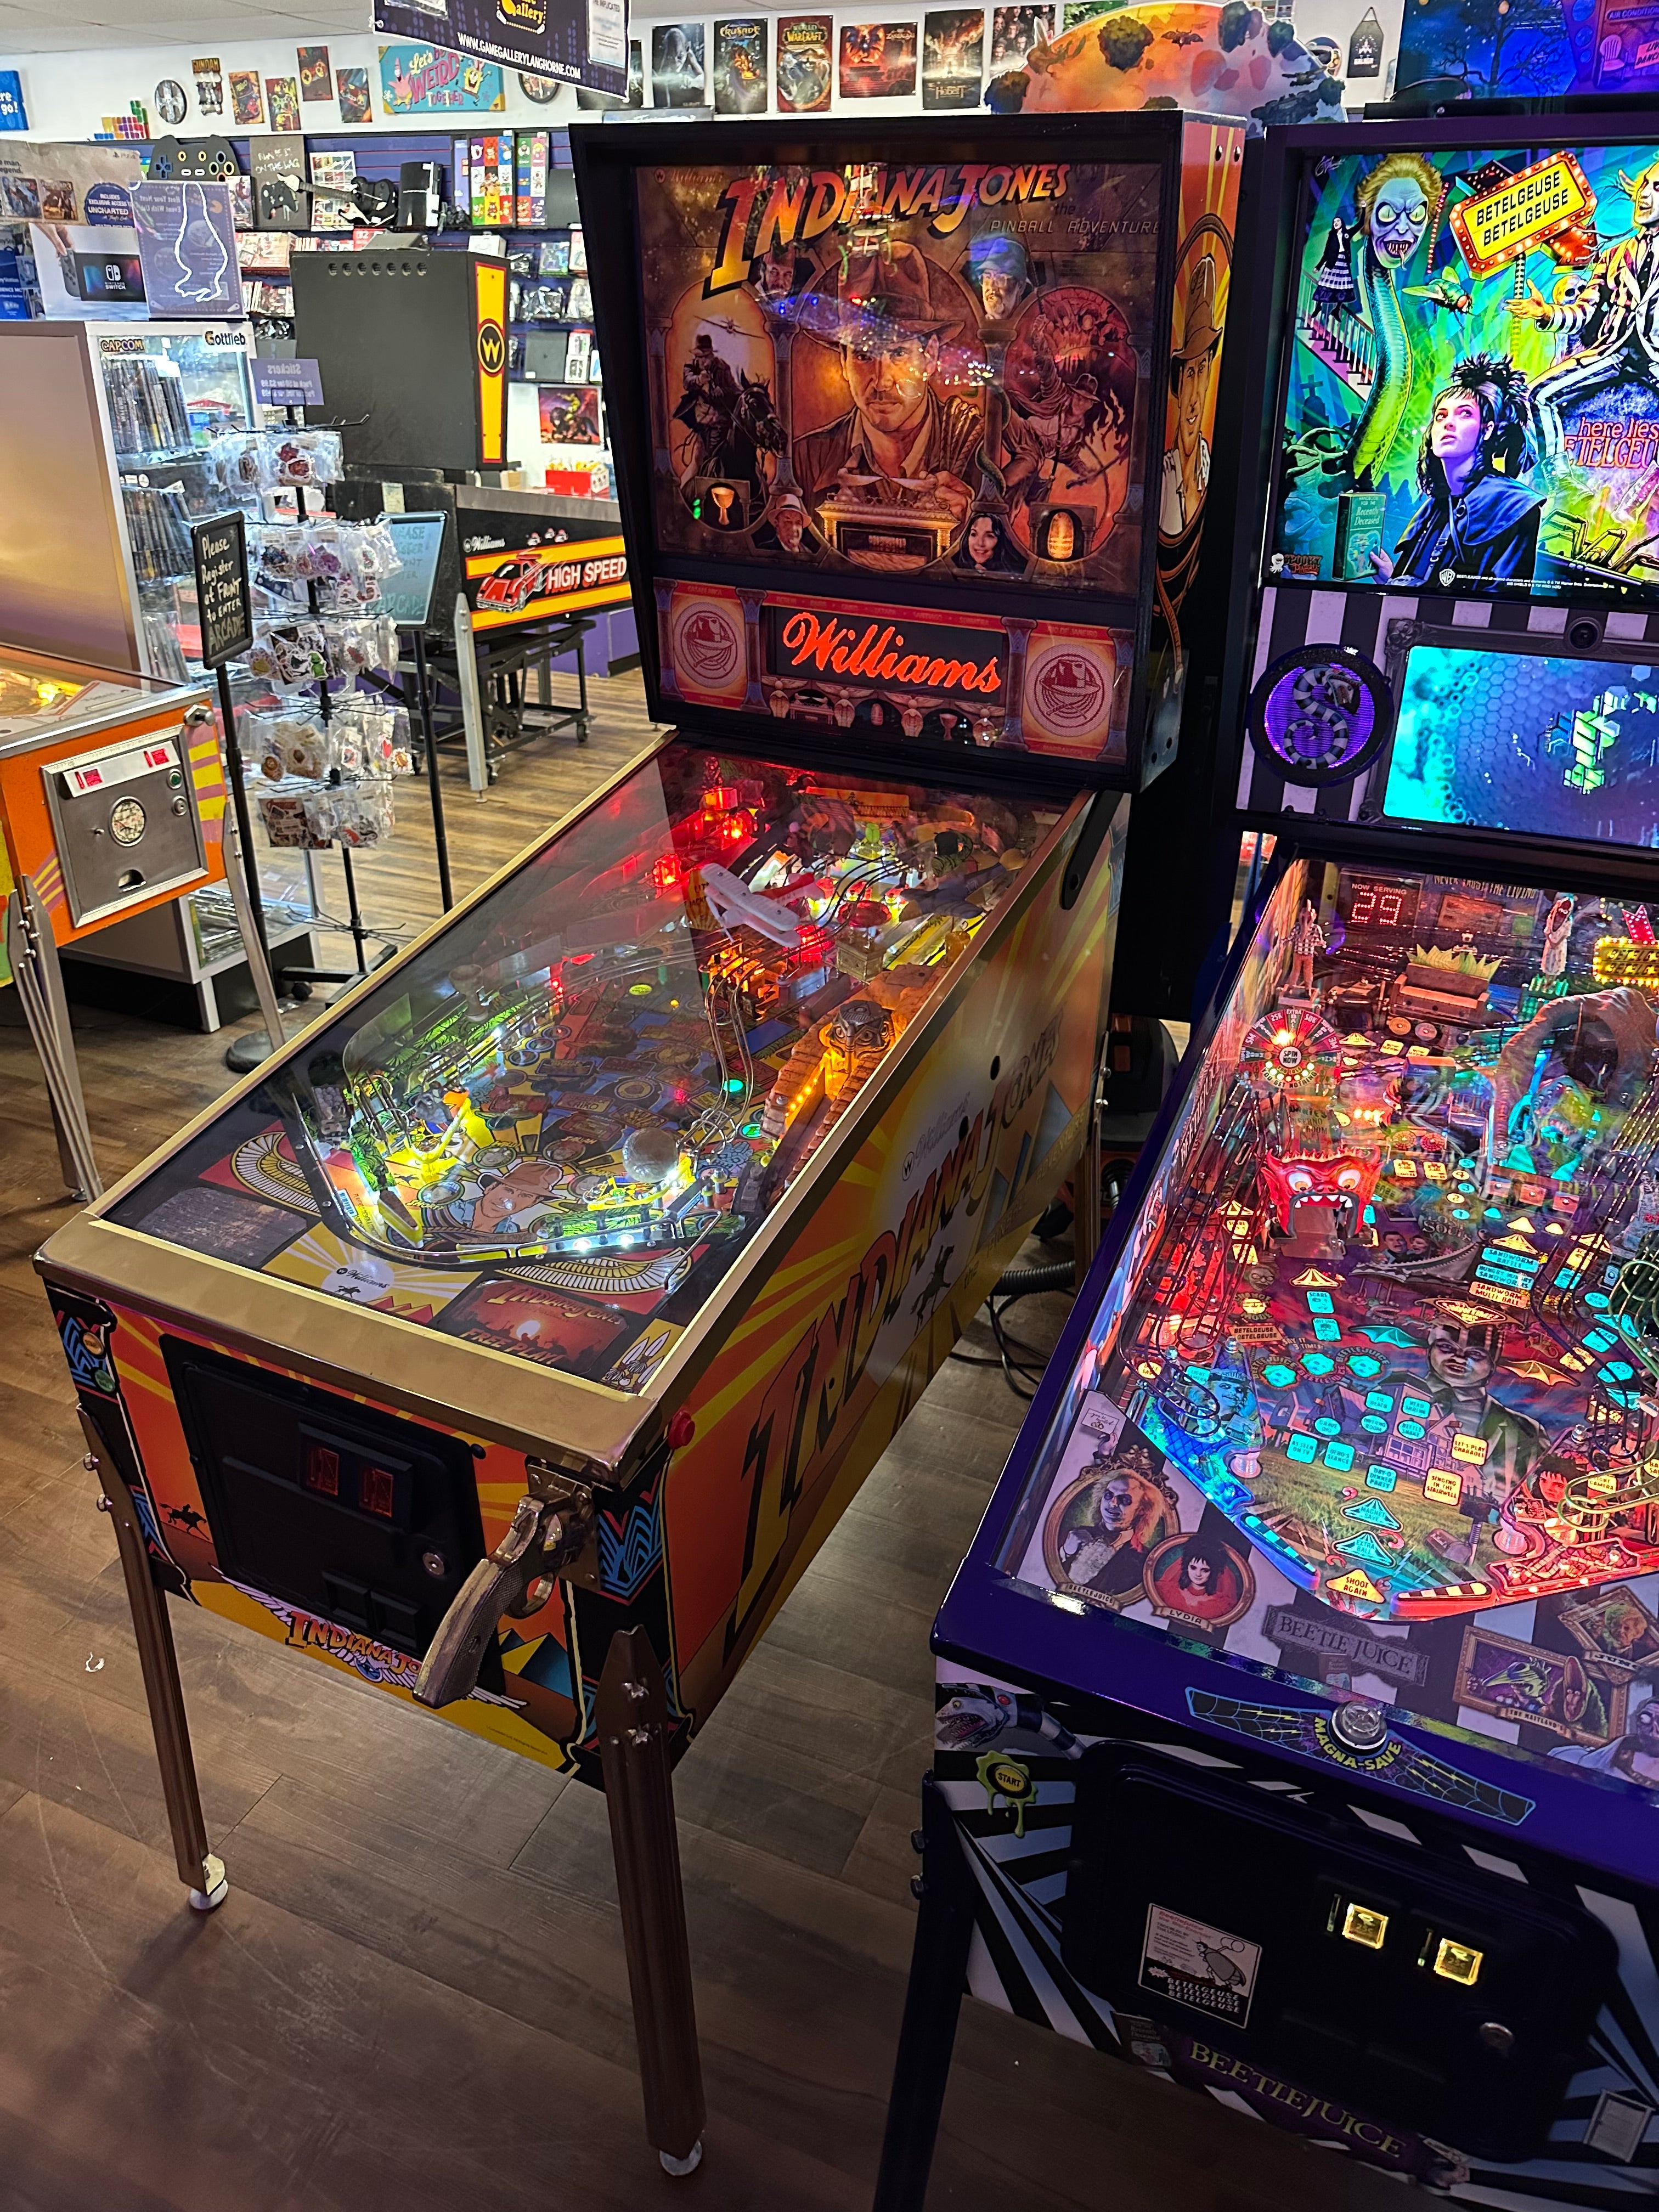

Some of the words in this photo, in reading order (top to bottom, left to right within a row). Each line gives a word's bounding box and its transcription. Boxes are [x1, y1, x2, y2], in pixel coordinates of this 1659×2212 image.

[720, 26, 761, 37] CRUSADE
[787, 31, 822, 42] WARCRAFT
[410, 50, 433, 75] Let's
[458, 32, 581, 80] WWW.GAMEGALLERYLANGHORNE.COM
[193, 59, 220, 72] GUNDAM
[935, 86, 966, 99] HOBBIT
[284, 158, 301, 170] LAG
[1476, 170, 1561, 227] BETELGEUSE
[88, 207, 129, 216] UNCHARTED
[1483, 188, 1569, 246] BETELGEUSE
[707, 166, 943, 295] INDIANA
[932, 165, 1071, 233] JONES
[989, 219, 1054, 234] PINBALL
[1068, 219, 1158, 234] ADVENTURE
[100, 338, 144, 352] CAPCOM
[205, 330, 246, 346] Gottlieb
[1578, 416, 1623, 438] here
[1627, 417, 1659, 439] lies
[1356, 506, 1379, 516] Recently
[1354, 516, 1380, 526] Deceased
[201, 534, 230, 560] Please
[471, 535, 505, 551] Williams
[201, 560, 234, 586] Register
[548, 565, 582, 591] HIGH
[584, 557, 627, 584] SPEED
[204, 585, 215, 606] at
[217, 577, 242, 602] FRONT
[207, 608, 216, 623] to
[218, 597, 242, 618] ENTER
[208, 612, 246, 656] ARCADE
[782, 611, 1001, 693] Williams
[1373, 885, 1407, 896] SERVING
[1271, 1012, 1283, 1022] 25K
[1262, 1067, 1273, 1081] YOU
[1273, 1079, 1286, 1088] GET
[1289, 1070, 1318, 1088] NOTHING
[1489, 1249, 1534, 1266] SANDWORM
[1497, 1257, 1522, 1268] BATTLE
[347, 1270, 391, 1288] Williams
[1479, 1265, 1504, 1276] HUNGRY
[1475, 1289, 1498, 1300] MULTI
[1502, 1296, 1519, 1306] BALL
[1477, 1283, 1522, 1300] SANDWORM
[487, 1284, 576, 1314] INDIANA
[563, 1305, 625, 1325] JONES
[460, 1328, 513, 1348] FREE
[507, 1343, 565, 1365] PLAY!
[1336, 1347, 1390, 1365] BEETLEJUICE
[1251, 1356, 1297, 1379] BEETLEJUICE
[1299, 1442, 1314, 1451] SEEN
[1454, 1446, 1485, 1459] CHARADES
[1455, 1440, 1469, 1449] LET'S
[1470, 1443, 1486, 1453] PLAY
[1369, 1472, 1393, 1483] DINNER
[1369, 1479, 1391, 1488] PARTY
[1431, 1475, 1457, 1487] SINGING
[1589, 1480, 1615, 1491] CAMERA
[1426, 1486, 1457, 1499] STAIRWELL
[1361, 1506, 1386, 1518] MAGNET
[1364, 1513, 1380, 1522] SAVE
[1356, 1539, 1376, 1549] EXTRA
[1357, 1546, 1371, 1555] BALL
[1343, 1584, 1368, 1598] AGAIN
[1345, 1576, 1369, 1590] SHOOT
[1068, 1583, 1114, 1605] BEETLEJUICE
[1169, 1607, 1203, 1626] LYDIA
[288, 1611, 393, 1664] INDIANA
[1509, 1708, 1524, 1719] THE
[1525, 1712, 1564, 1732] MAITLAND'S
[1314, 1716, 1402, 1772] MAGNA-SAVE
[997, 1771, 1022, 1788] START
[1167, 1978, 1240, 2001] BETELGEUSE
[1168, 1984, 1240, 2007] BETELGEUSE
[1169, 1990, 1240, 2014] BETELGEUSE
[1190, 2040, 1408, 2159] BEETLEJUICE
